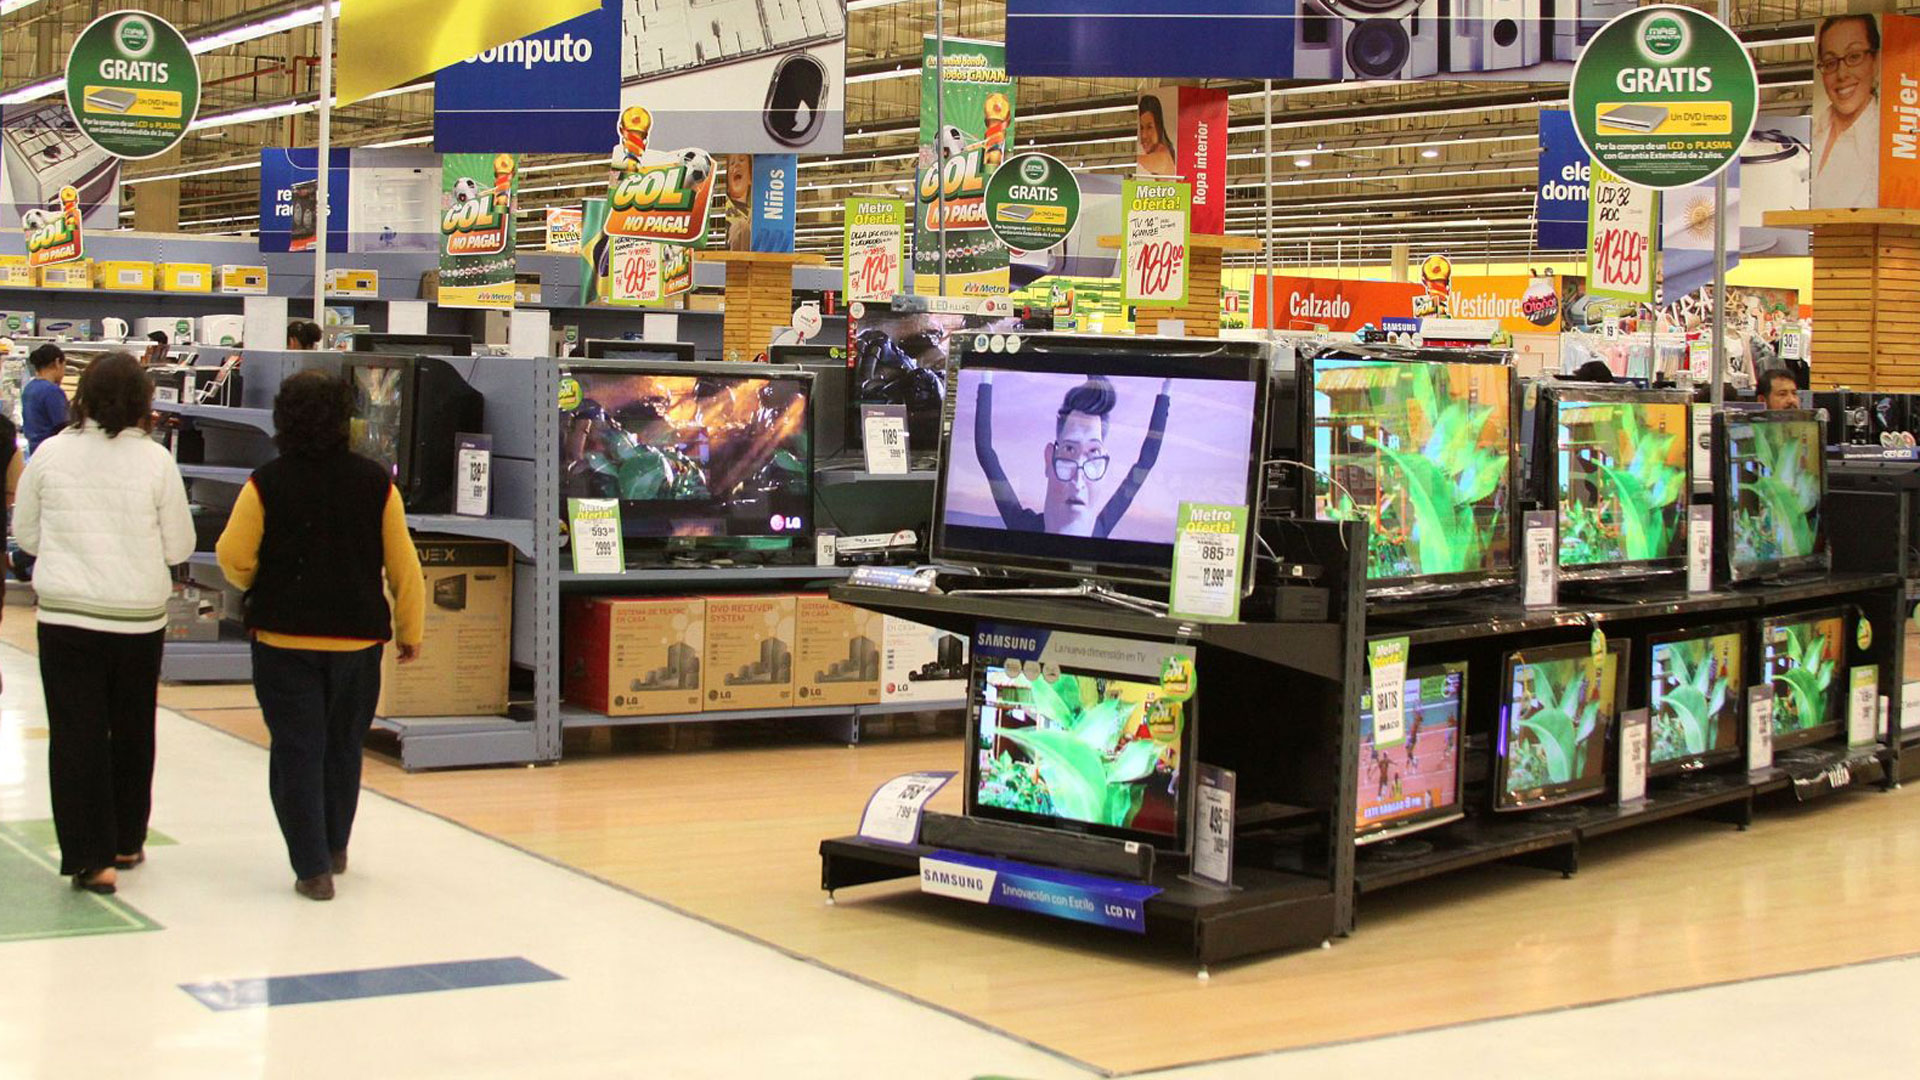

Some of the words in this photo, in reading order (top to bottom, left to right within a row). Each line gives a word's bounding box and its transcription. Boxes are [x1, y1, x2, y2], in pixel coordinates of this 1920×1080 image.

[463, 33, 593, 69] omputo
[100, 59, 169, 83] GRATIS
[1616, 67, 1712, 93] GRATIS
[1671, 113, 1681, 121] Un
[1683, 113, 1701, 121] DVD
[1892, 73, 1920, 159] Mujer
[1193, 120, 1208, 169] interior
[1617, 143, 1644, 151] compra
[1667, 141, 1684, 150] LCD
[1695, 141, 1732, 150] PLASMA
[1650, 151, 1686, 159] Extendida
[1688, 151, 1697, 159] de
[1698, 151, 1703, 159] 2
[921, 151, 983, 198] GOL
[613, 167, 683, 206] GOL
[763, 169, 785, 220] Niños
[1009, 185, 1058, 201] GRATIS
[1136, 185, 1176, 199] Metro
[1192, 172, 1209, 205] Ropa
[1542, 180, 1590, 200] dom
[1132, 196, 1180, 211] Oferta!
[1617, 187, 1631, 206] 32
[442, 194, 493, 231] GOL
[858, 203, 893, 214] Metro
[622, 216, 644, 232] NO
[644, 214, 691, 234] PAGA!
[854, 212, 897, 225] Oferta!
[29, 219, 67, 250] GOL
[452, 236, 466, 249] NO
[466, 232, 500, 249] PAGA!
[979, 282, 1006, 294] Metro
[490, 292, 513, 301] Metro
[1451, 290, 1524, 319] Vestidore
[996, 303, 1007, 311] LG
[1289, 291, 1351, 319] Calzado
[1382, 323, 1417, 332] SAMSUNG
[1783, 334, 1793, 348] 30
[785, 516, 801, 529] LG
[1191, 509, 1232, 522] Metro
[1186, 520, 1236, 533] Oferta!
[710, 604, 730, 613] DVD
[732, 603, 773, 613] RECEIVER
[710, 614, 745, 623] SYSTEM
[977, 632, 1037, 652] SAMSUNG
[720, 691, 731, 699] LG
[810, 688, 822, 696] LG
[626, 697, 638, 705] LG
[924, 868, 984, 892] SAMSUNG
[1002, 882, 1050, 902] Innovación
[1051, 893, 1068, 907] con
[1069, 896, 1095, 913] Estilo
[1105, 904, 1123, 918] LCD
[1125, 908, 1137, 921] TV
